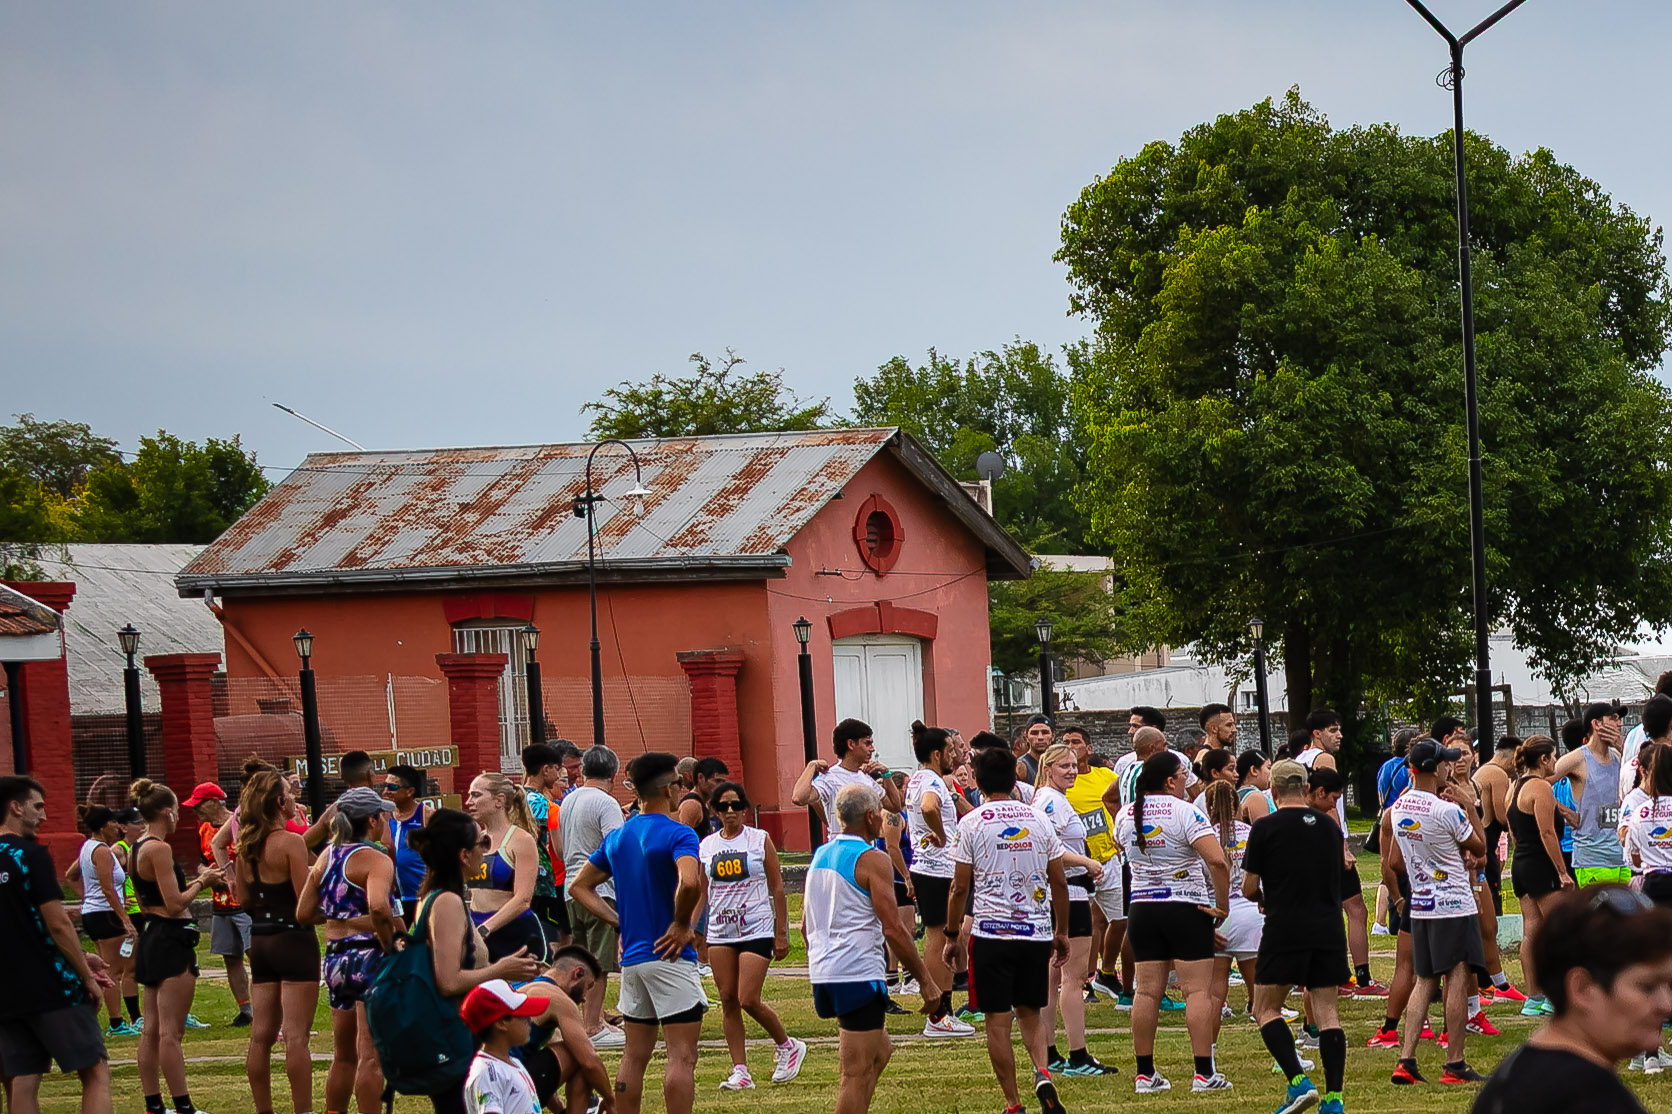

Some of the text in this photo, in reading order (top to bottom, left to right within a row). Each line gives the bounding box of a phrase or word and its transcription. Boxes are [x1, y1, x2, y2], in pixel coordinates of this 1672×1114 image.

[295, 749, 452, 776] MSE LA CIUDAD
[1402, 804, 1431, 813] SEGUROS
[1605, 807, 1621, 822] 15
[1083, 813, 1104, 831] 174
[996, 842, 1033, 850] REDCOLOR
[716, 858, 742, 877] 608
